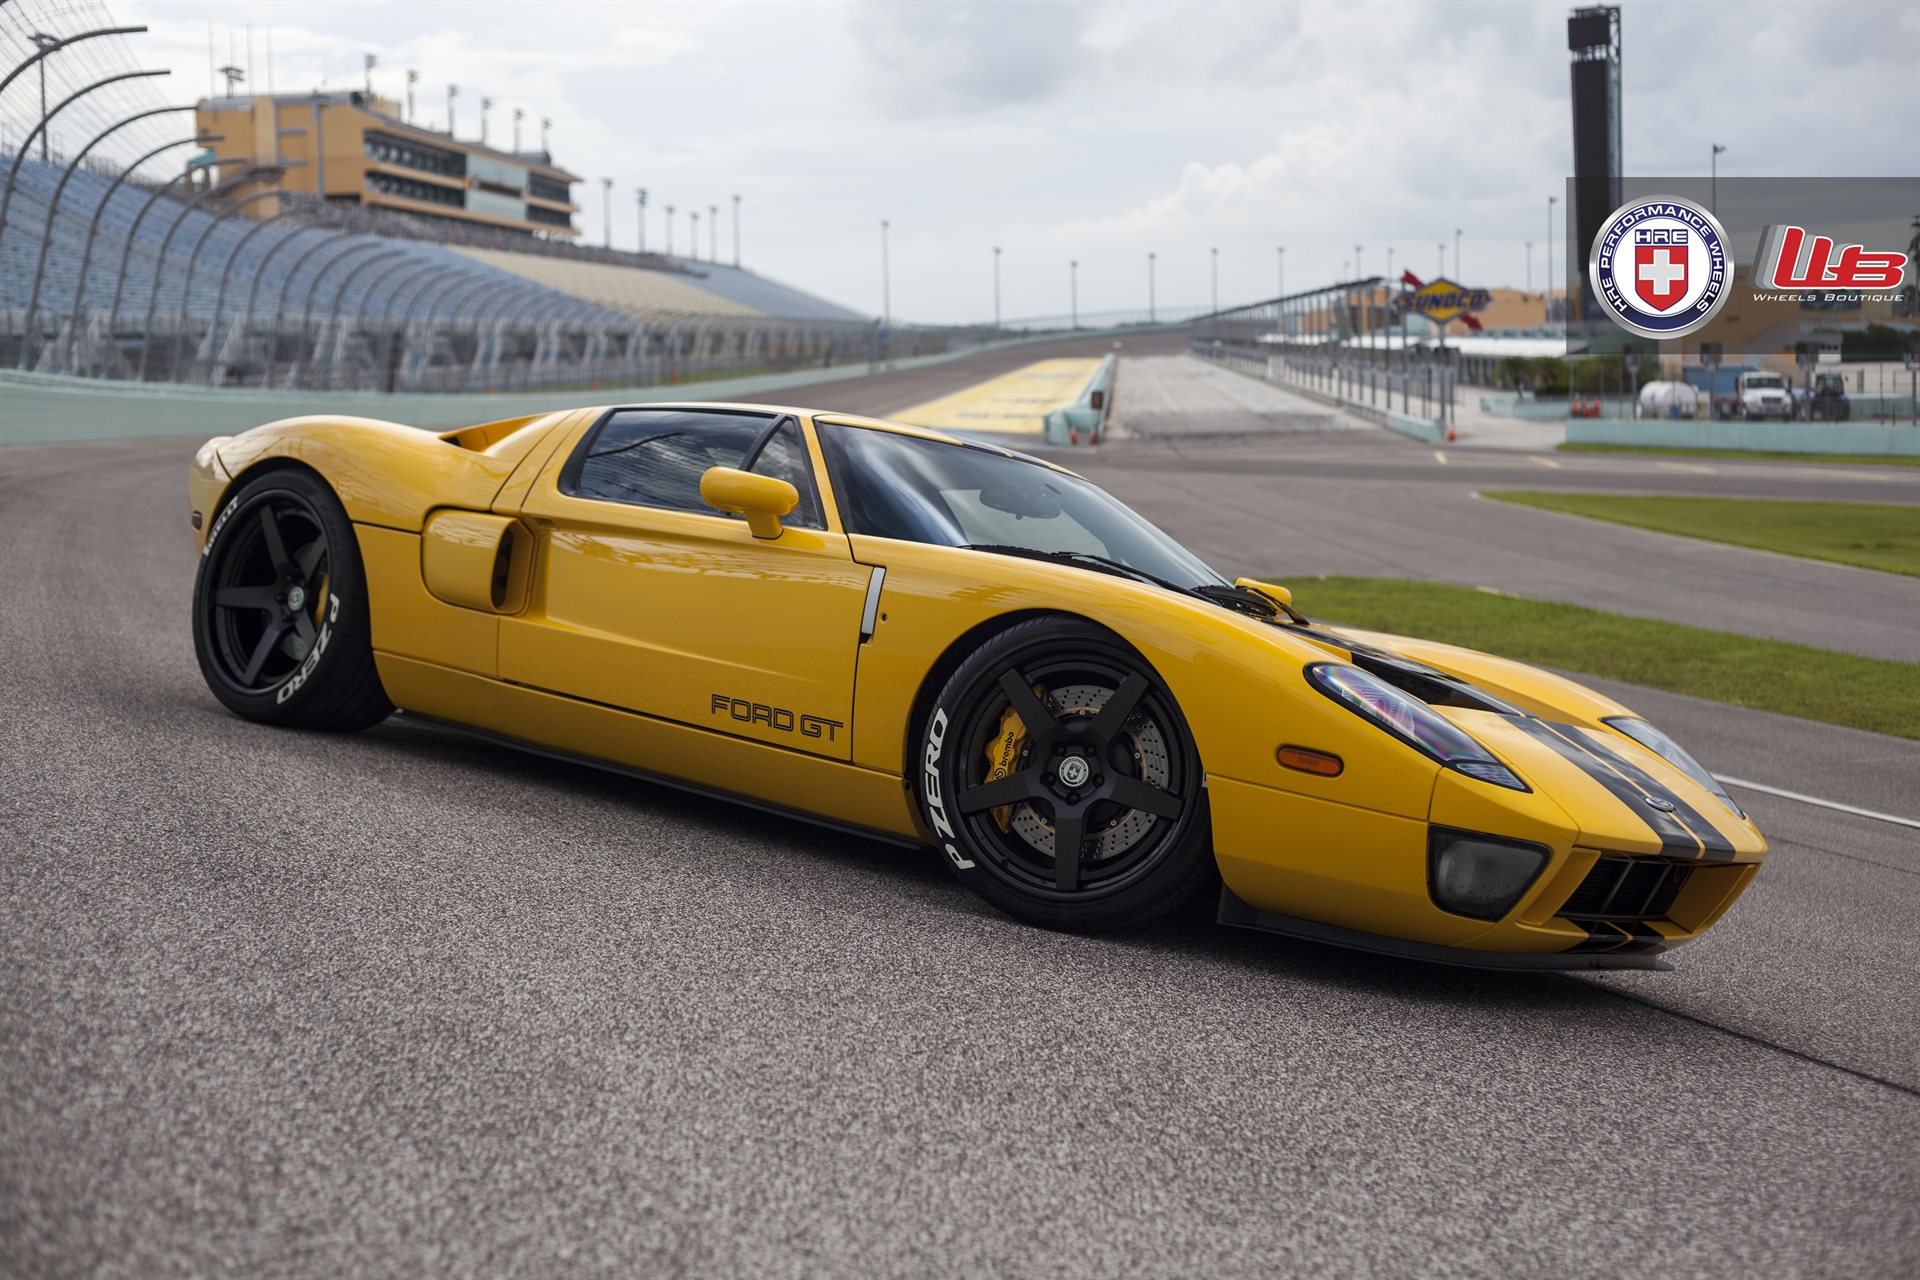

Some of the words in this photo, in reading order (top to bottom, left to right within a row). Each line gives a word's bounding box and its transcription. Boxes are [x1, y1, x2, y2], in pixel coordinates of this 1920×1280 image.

[1401, 290, 1485, 310] SUNOCO
[329, 592, 340, 623] P
[276, 621, 333, 705] ZERO
[711, 693, 794, 732] FORD
[800, 713, 844, 742] GT
[998, 731, 1015, 767] brembo
[925, 707, 956, 839] ZERO
[944, 843, 976, 870] P
